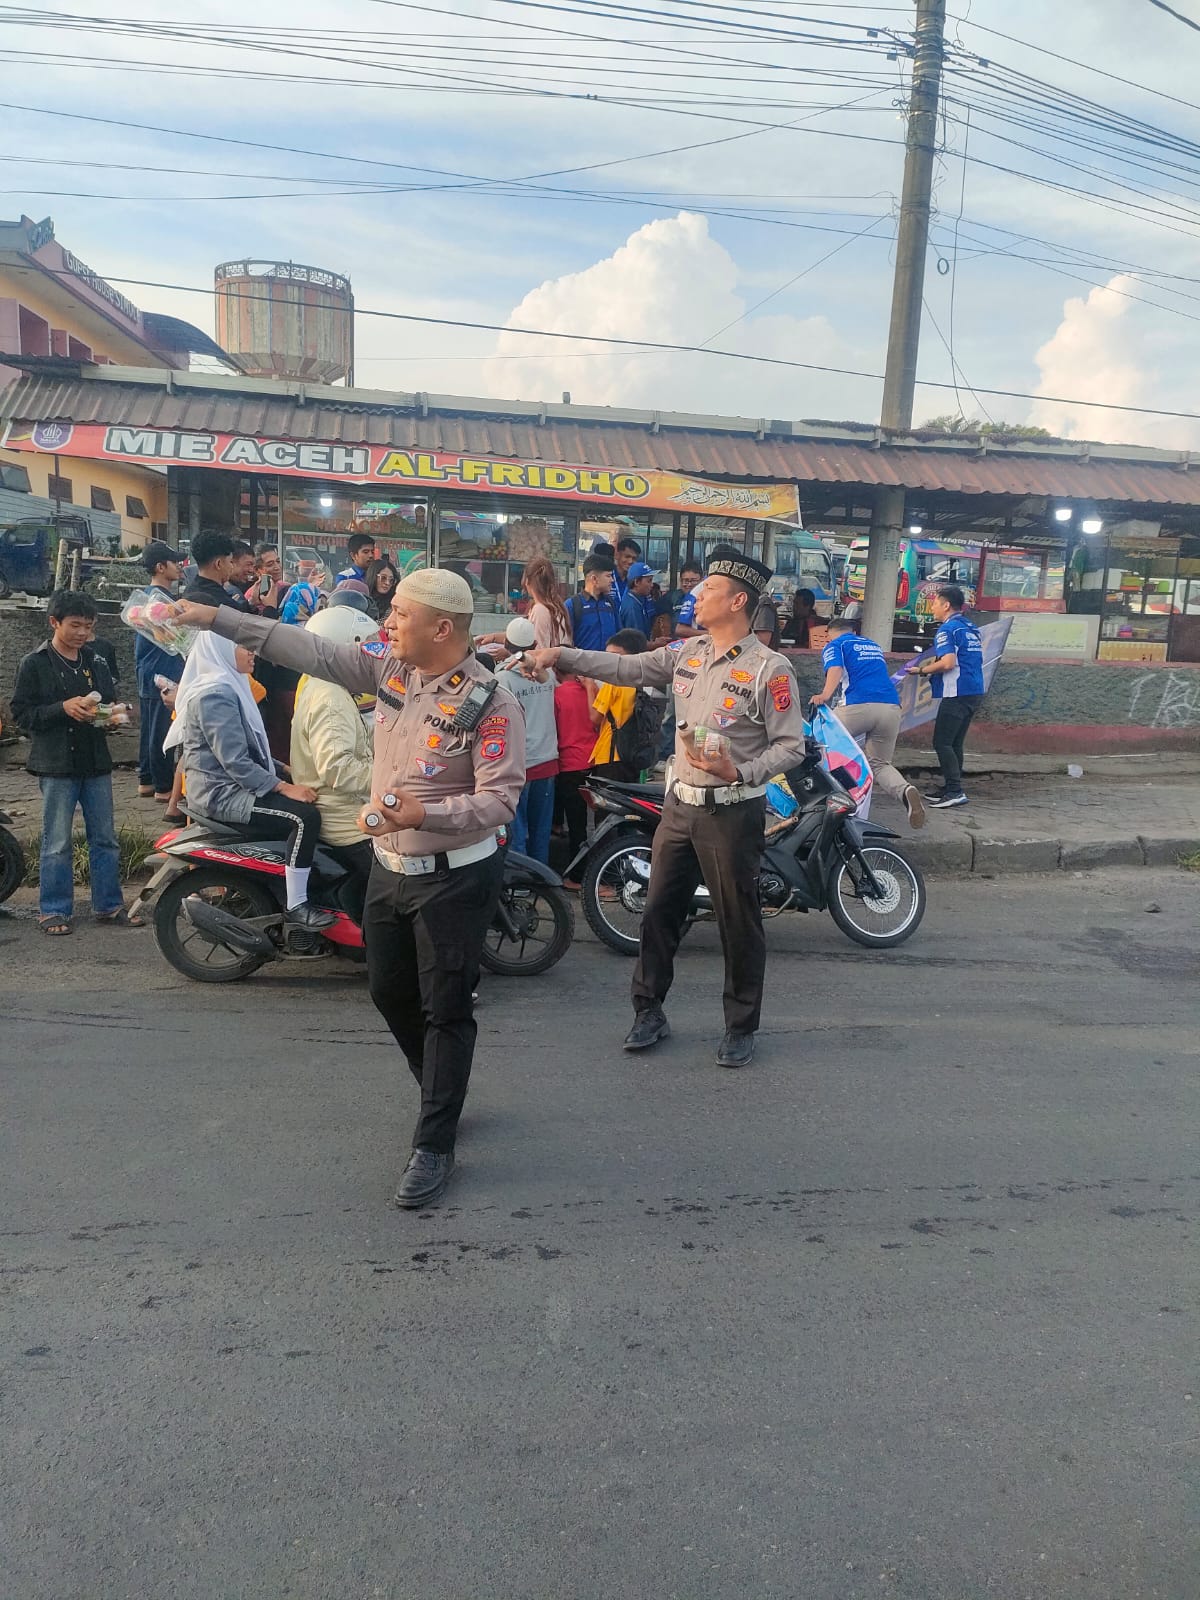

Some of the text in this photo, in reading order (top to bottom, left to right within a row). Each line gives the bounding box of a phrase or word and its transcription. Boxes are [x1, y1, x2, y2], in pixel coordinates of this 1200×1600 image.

[106, 427, 651, 502] MIE ACEH AL-FRIDHO
[291, 535, 317, 546] NASI
[721, 681, 752, 699] POLRI
[423, 713, 461, 738] POLRI
